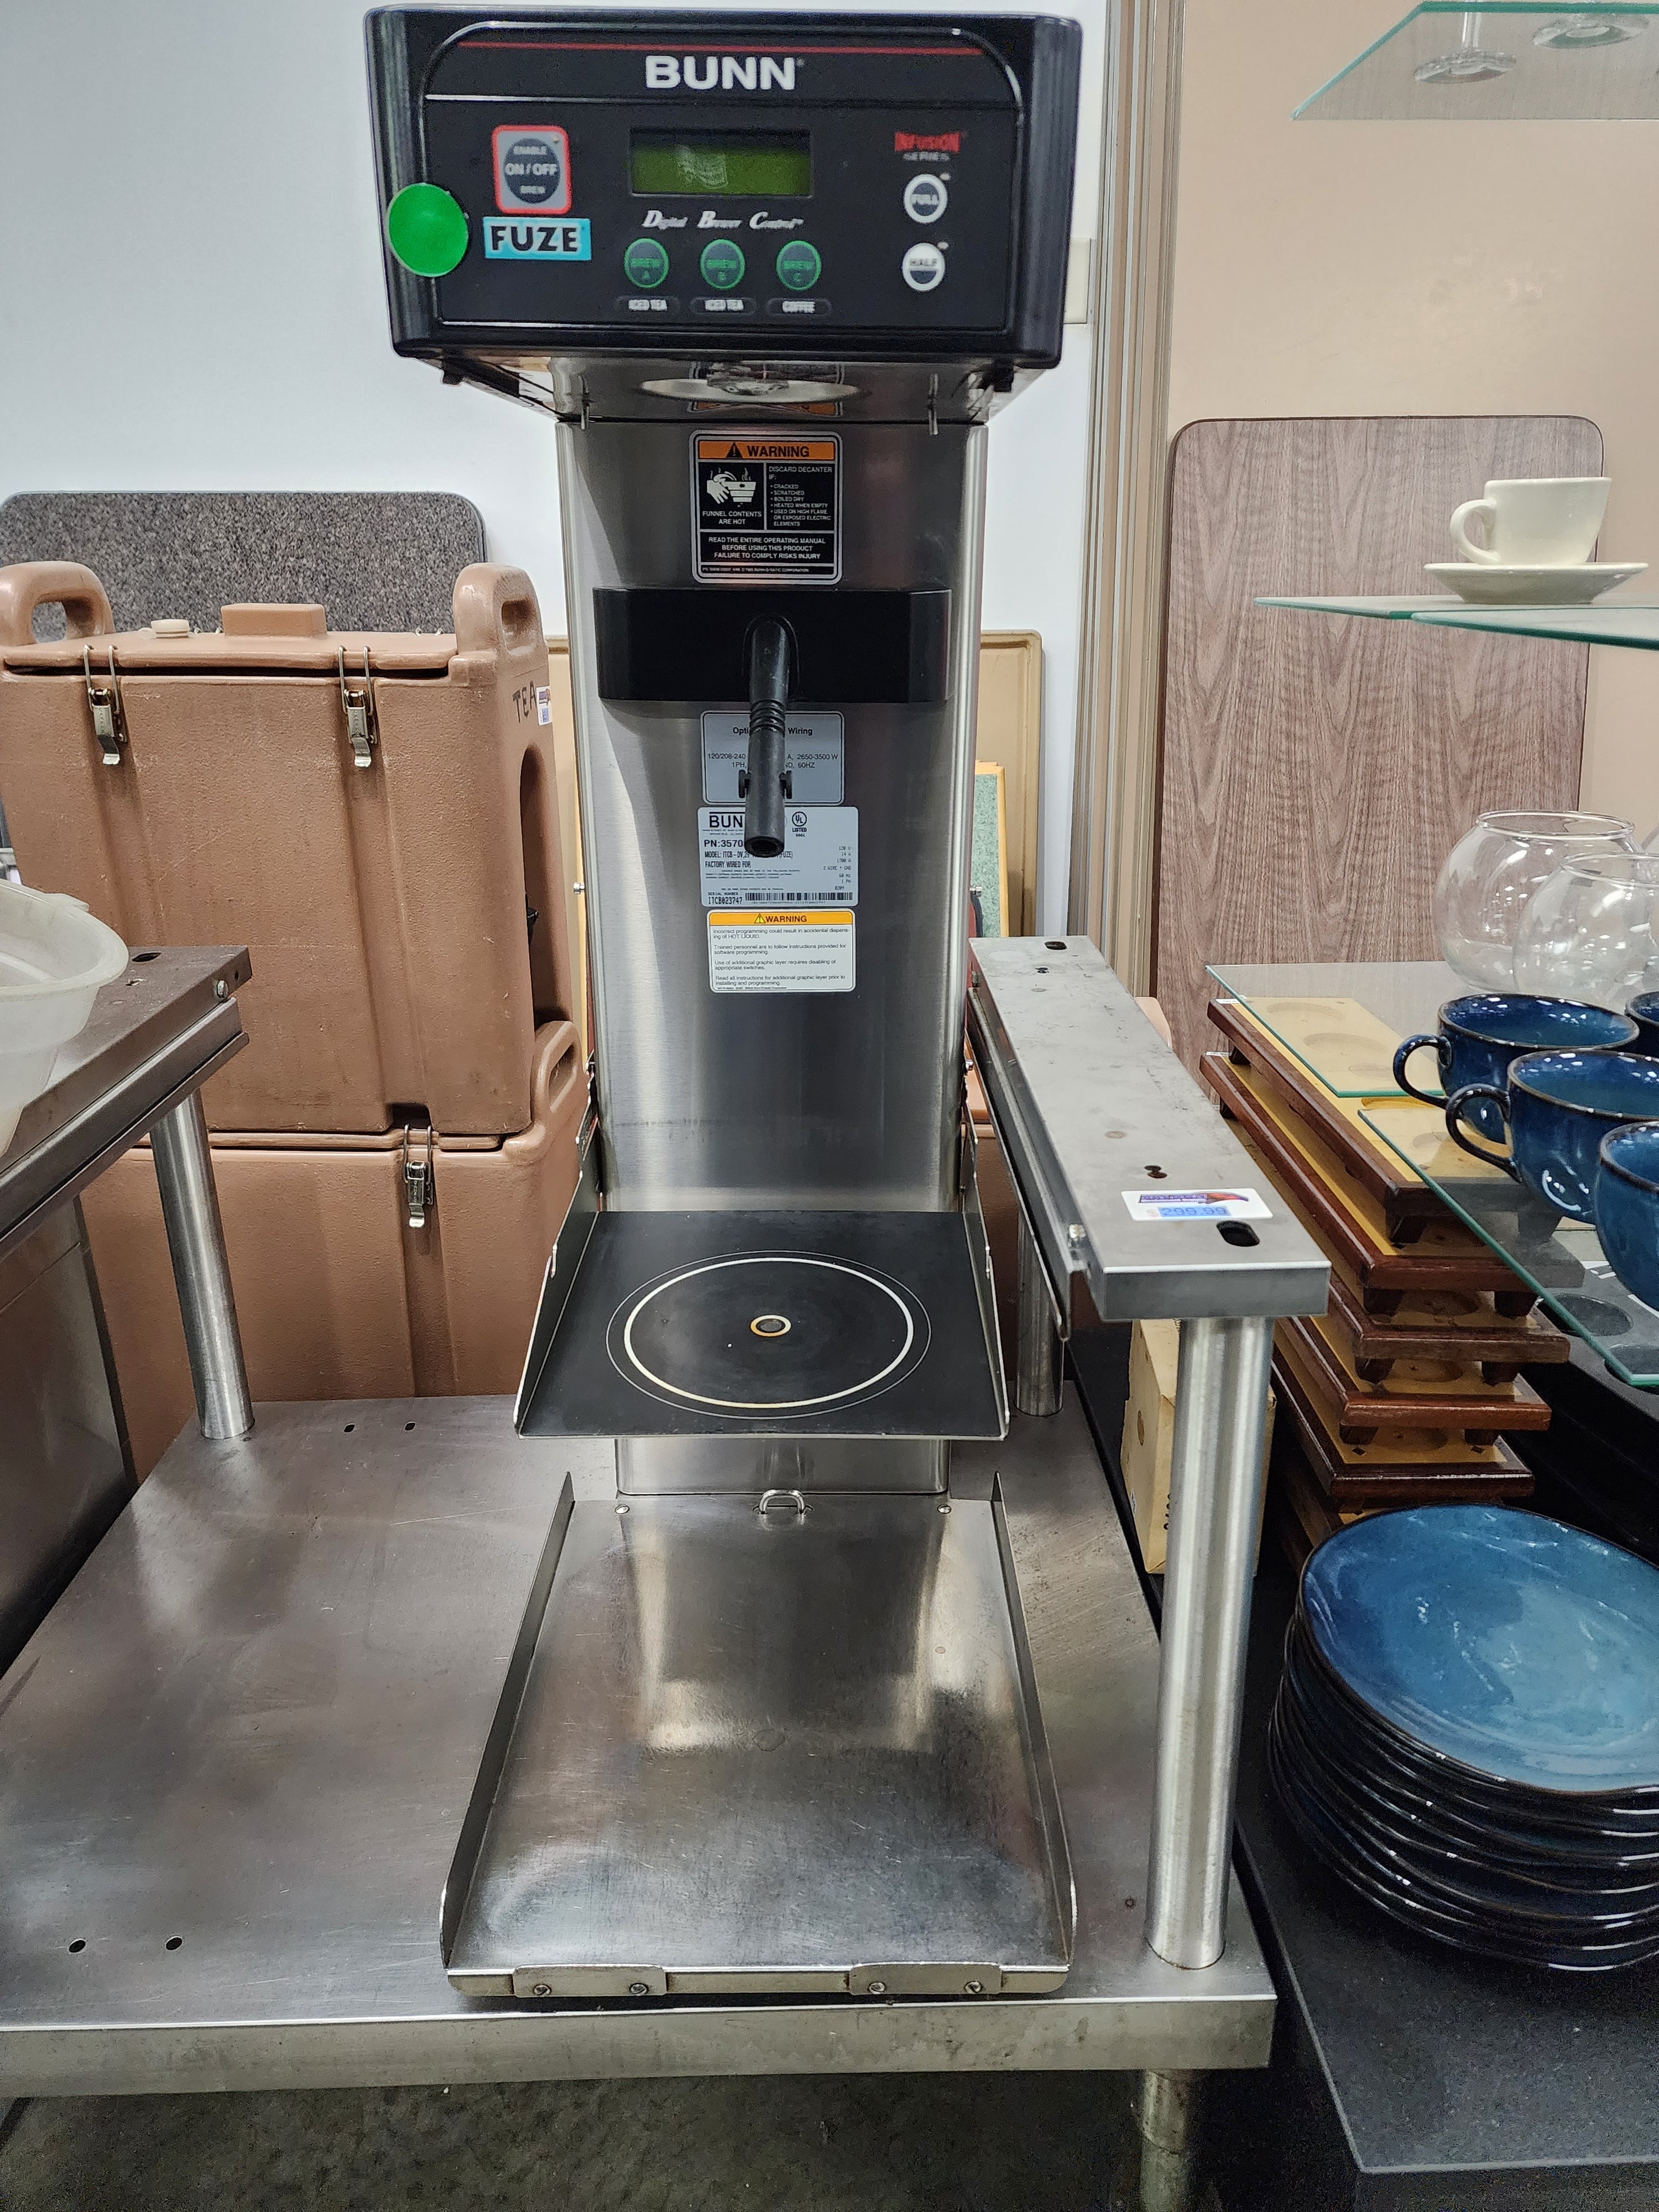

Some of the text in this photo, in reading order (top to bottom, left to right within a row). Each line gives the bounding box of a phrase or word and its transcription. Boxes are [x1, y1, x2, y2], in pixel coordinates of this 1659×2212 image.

[645, 55, 795, 90] BUNN
[491, 226, 581, 252] FUZE
[909, 258, 937, 267] HALF
[747, 445, 810, 457] WARNING
[512, 680, 538, 723] TEA
